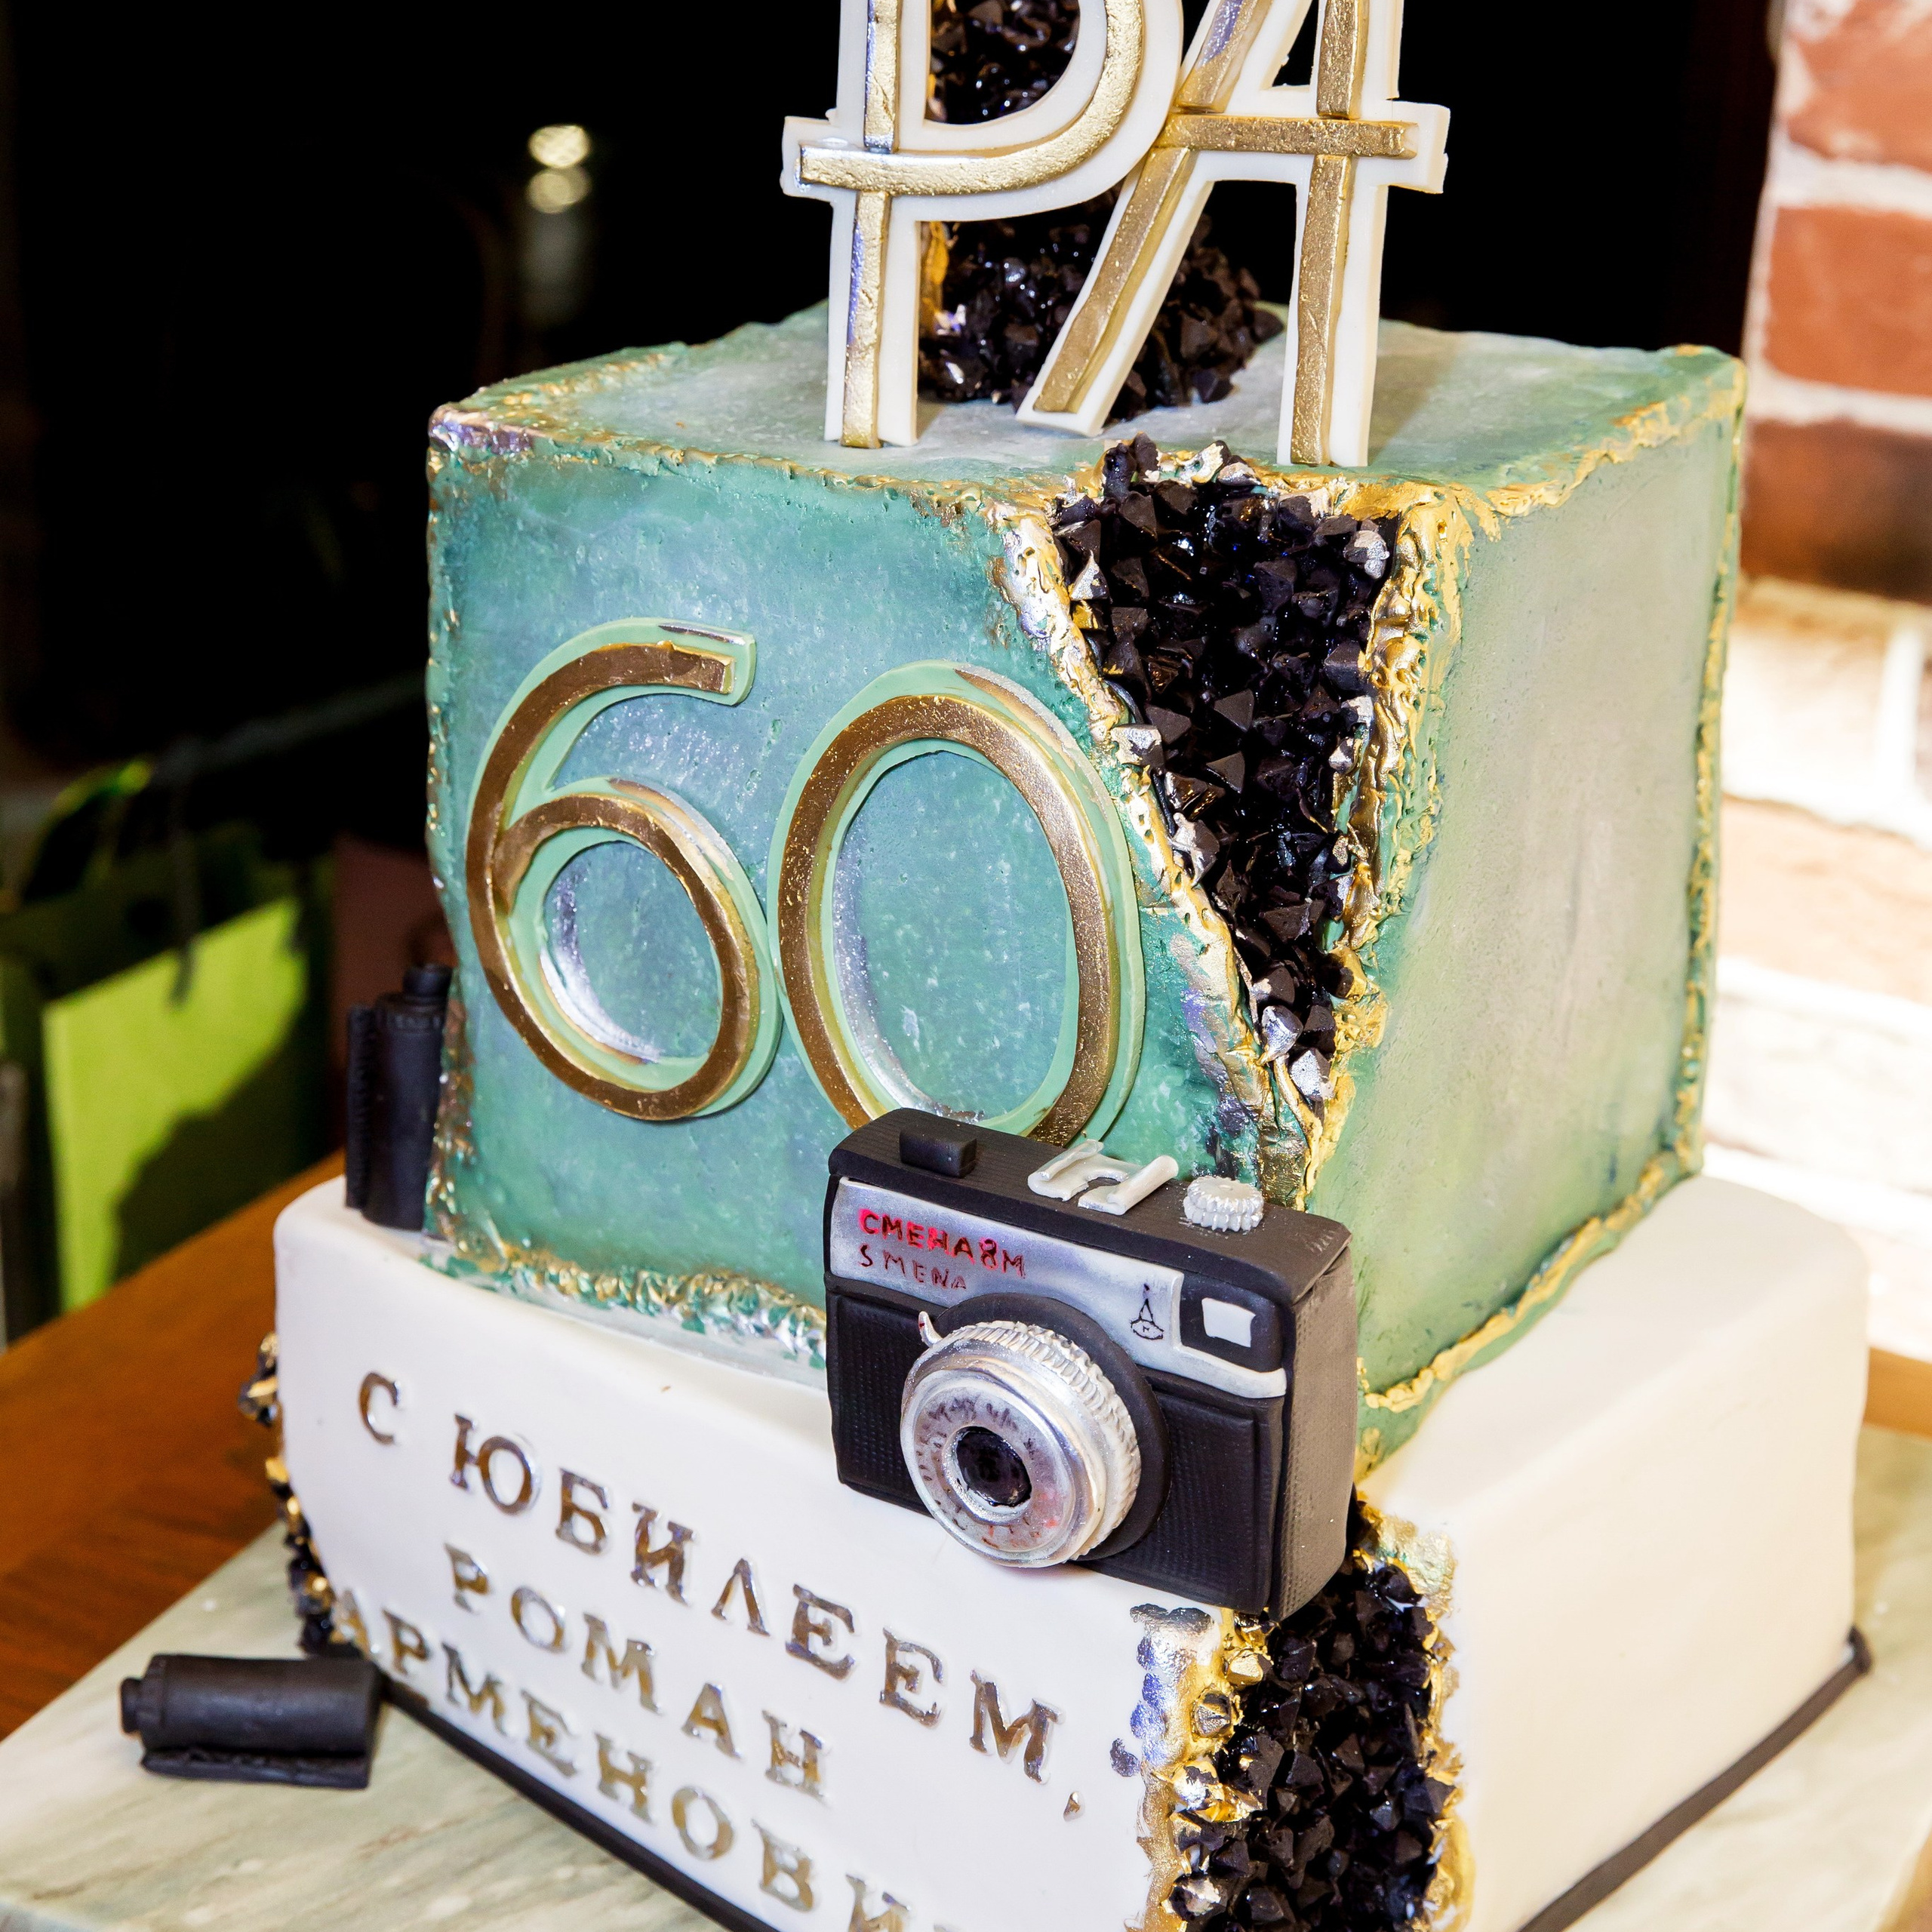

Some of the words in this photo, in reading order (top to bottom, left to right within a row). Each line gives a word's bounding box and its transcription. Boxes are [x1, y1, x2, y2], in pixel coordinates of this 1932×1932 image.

[466, 617, 1145, 1146] 60
[858, 1244, 968, 1290] SMENA
[358, 1371, 401, 1444] С
[329, 1589, 970, 1932] АРМЕНОВИ
[444, 1543, 830, 1802] РОМАН
